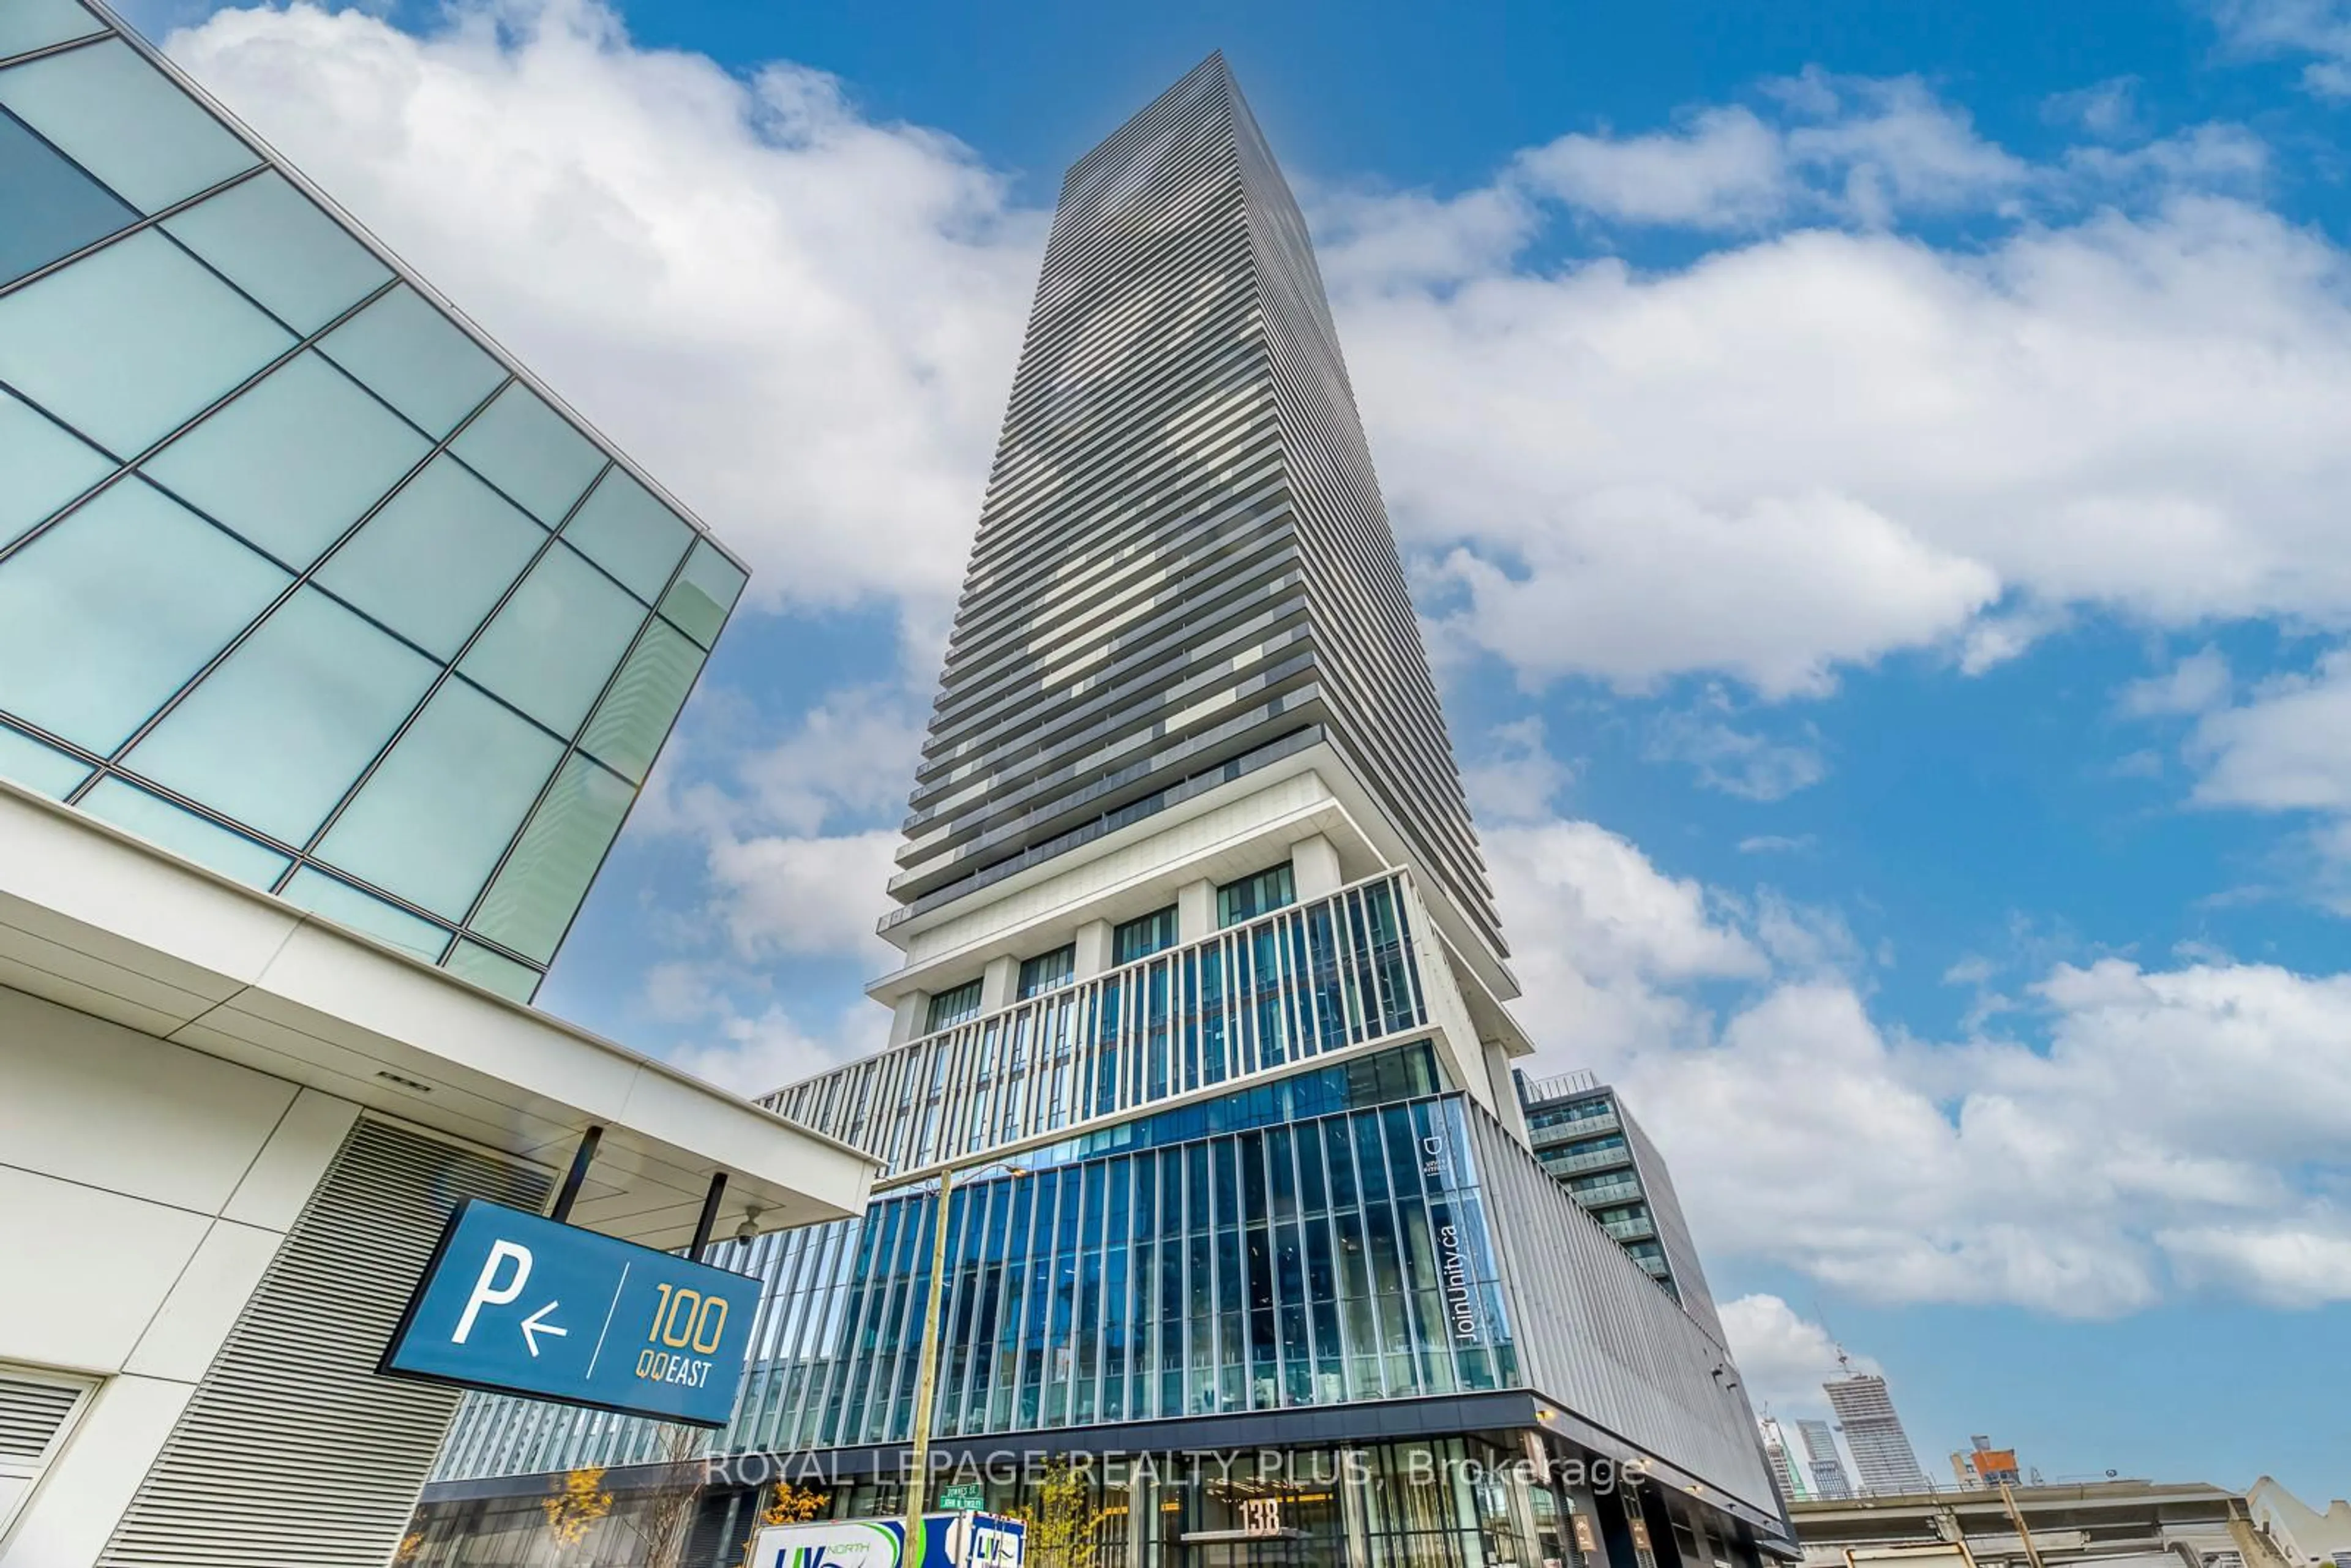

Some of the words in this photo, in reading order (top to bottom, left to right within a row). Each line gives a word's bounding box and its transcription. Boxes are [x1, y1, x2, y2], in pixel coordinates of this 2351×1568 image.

[451, 1239, 533, 1345] P
[1441, 1224, 1477, 1341] JoinUnity.ca
[648, 1283, 729, 1355] 100
[827, 1542, 870, 1555] NORTH
[1239, 1499, 1280, 1536] 138
